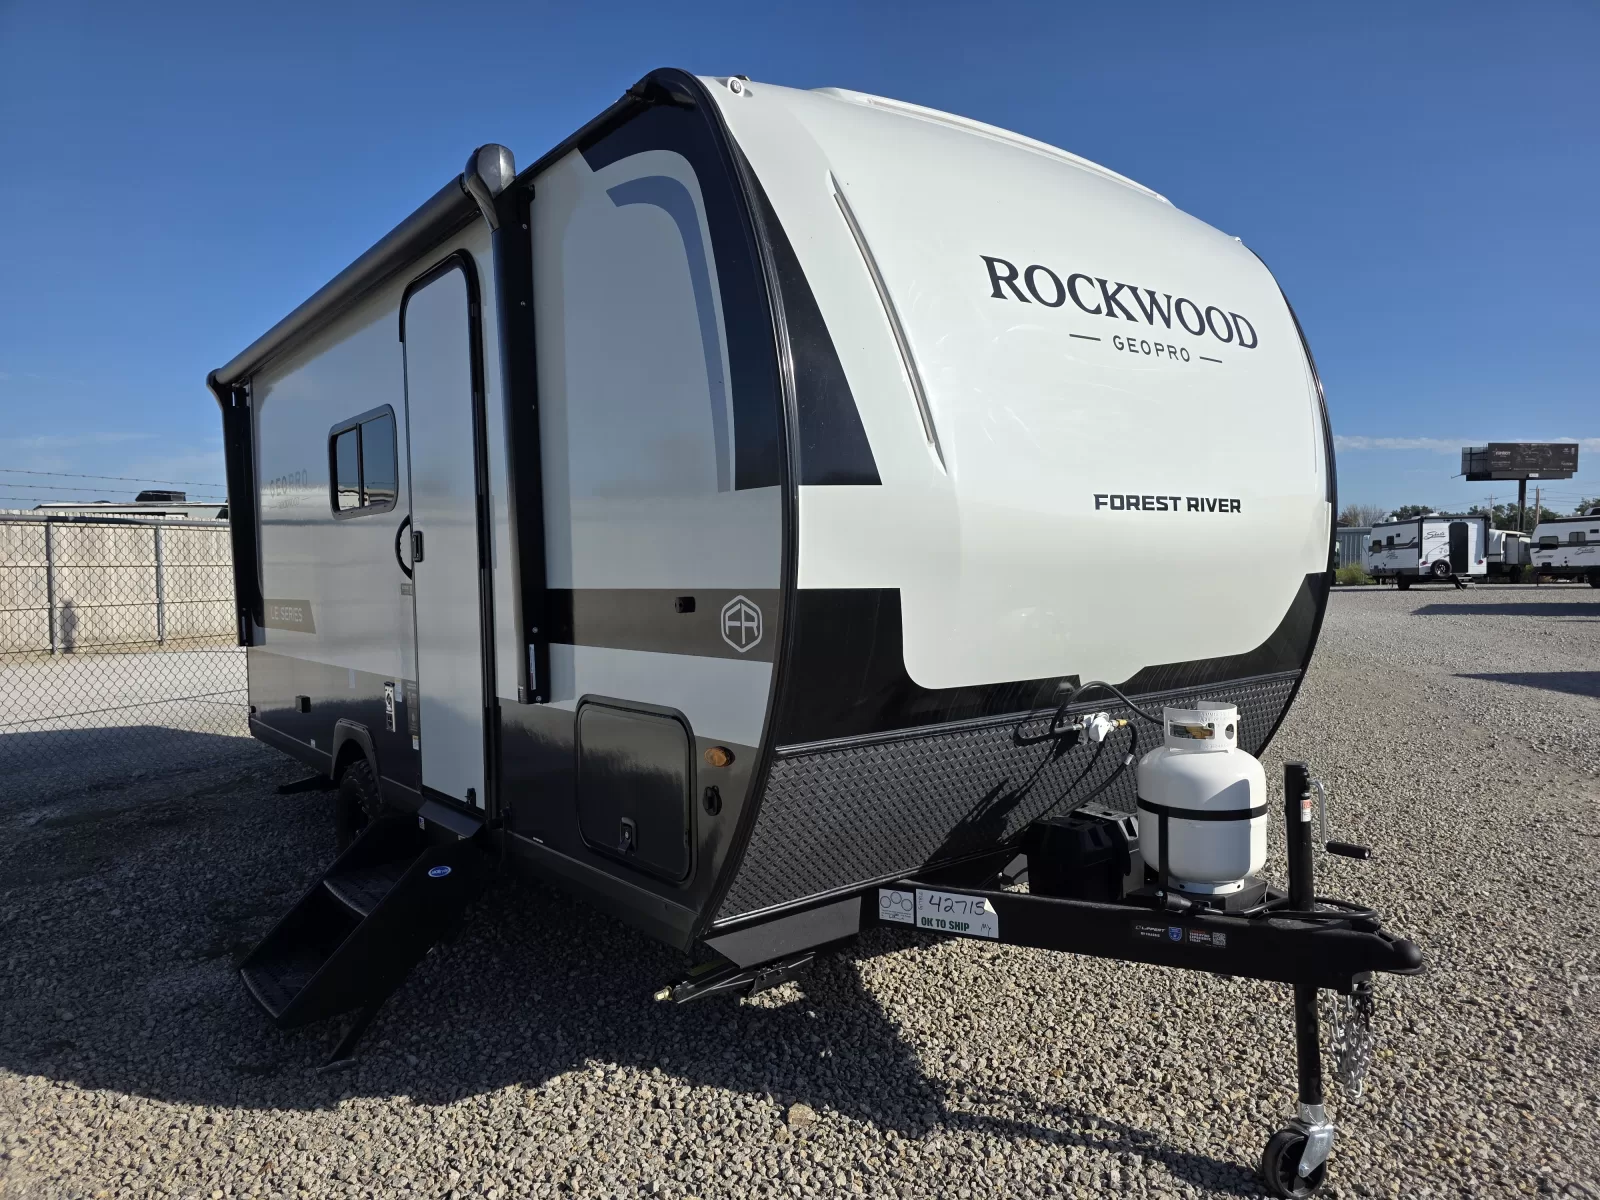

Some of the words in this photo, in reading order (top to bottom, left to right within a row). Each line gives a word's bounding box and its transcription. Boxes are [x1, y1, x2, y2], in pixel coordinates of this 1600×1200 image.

[979, 255, 1258, 349] ROCKWOOD
[1113, 335, 1190, 362] GEOPRO
[270, 468, 308, 497] GEOPRO
[1093, 494, 1181, 512] FOREST
[1185, 496, 1241, 513] RIVER
[271, 606, 279, 620] LE
[280, 607, 303, 622] SERIES
[921, 916, 933, 928] OK
[935, 918, 946, 929] TO
[949, 921, 970, 932] SHIP
